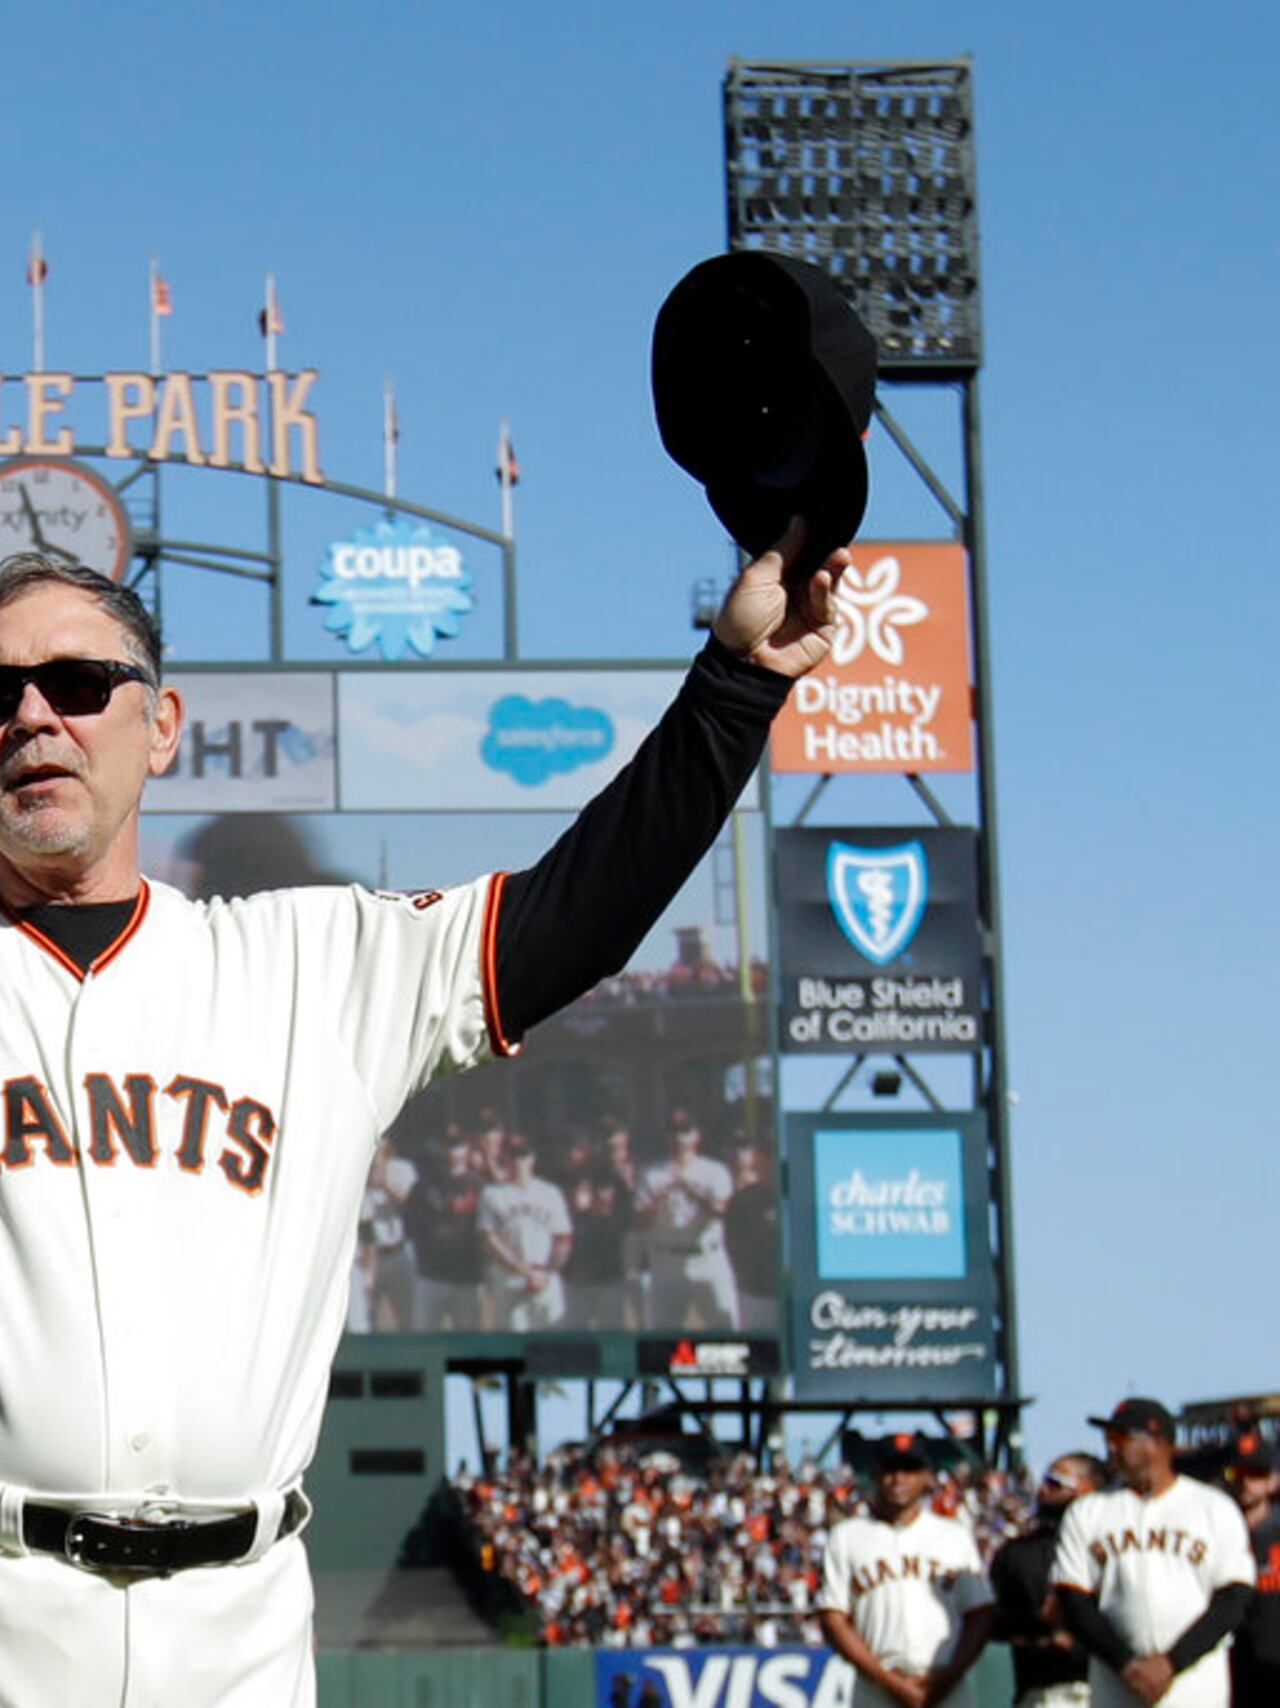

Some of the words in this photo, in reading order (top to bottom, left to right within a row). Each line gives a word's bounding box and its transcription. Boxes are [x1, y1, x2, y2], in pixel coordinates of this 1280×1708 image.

[104, 370, 326, 484] PARK
[333, 545, 462, 588] coupa
[795, 676, 941, 725] Dignity
[803, 722, 939, 761] Health
[798, 977, 864, 1010] Blue
[872, 976, 964, 1009] Shield
[789, 1012, 821, 1042] of
[827, 1010, 977, 1042] California
[831, 1168, 949, 1208] charles
[831, 1210, 951, 1236] SCHWAB
[653, 1653, 858, 1708] VISA
